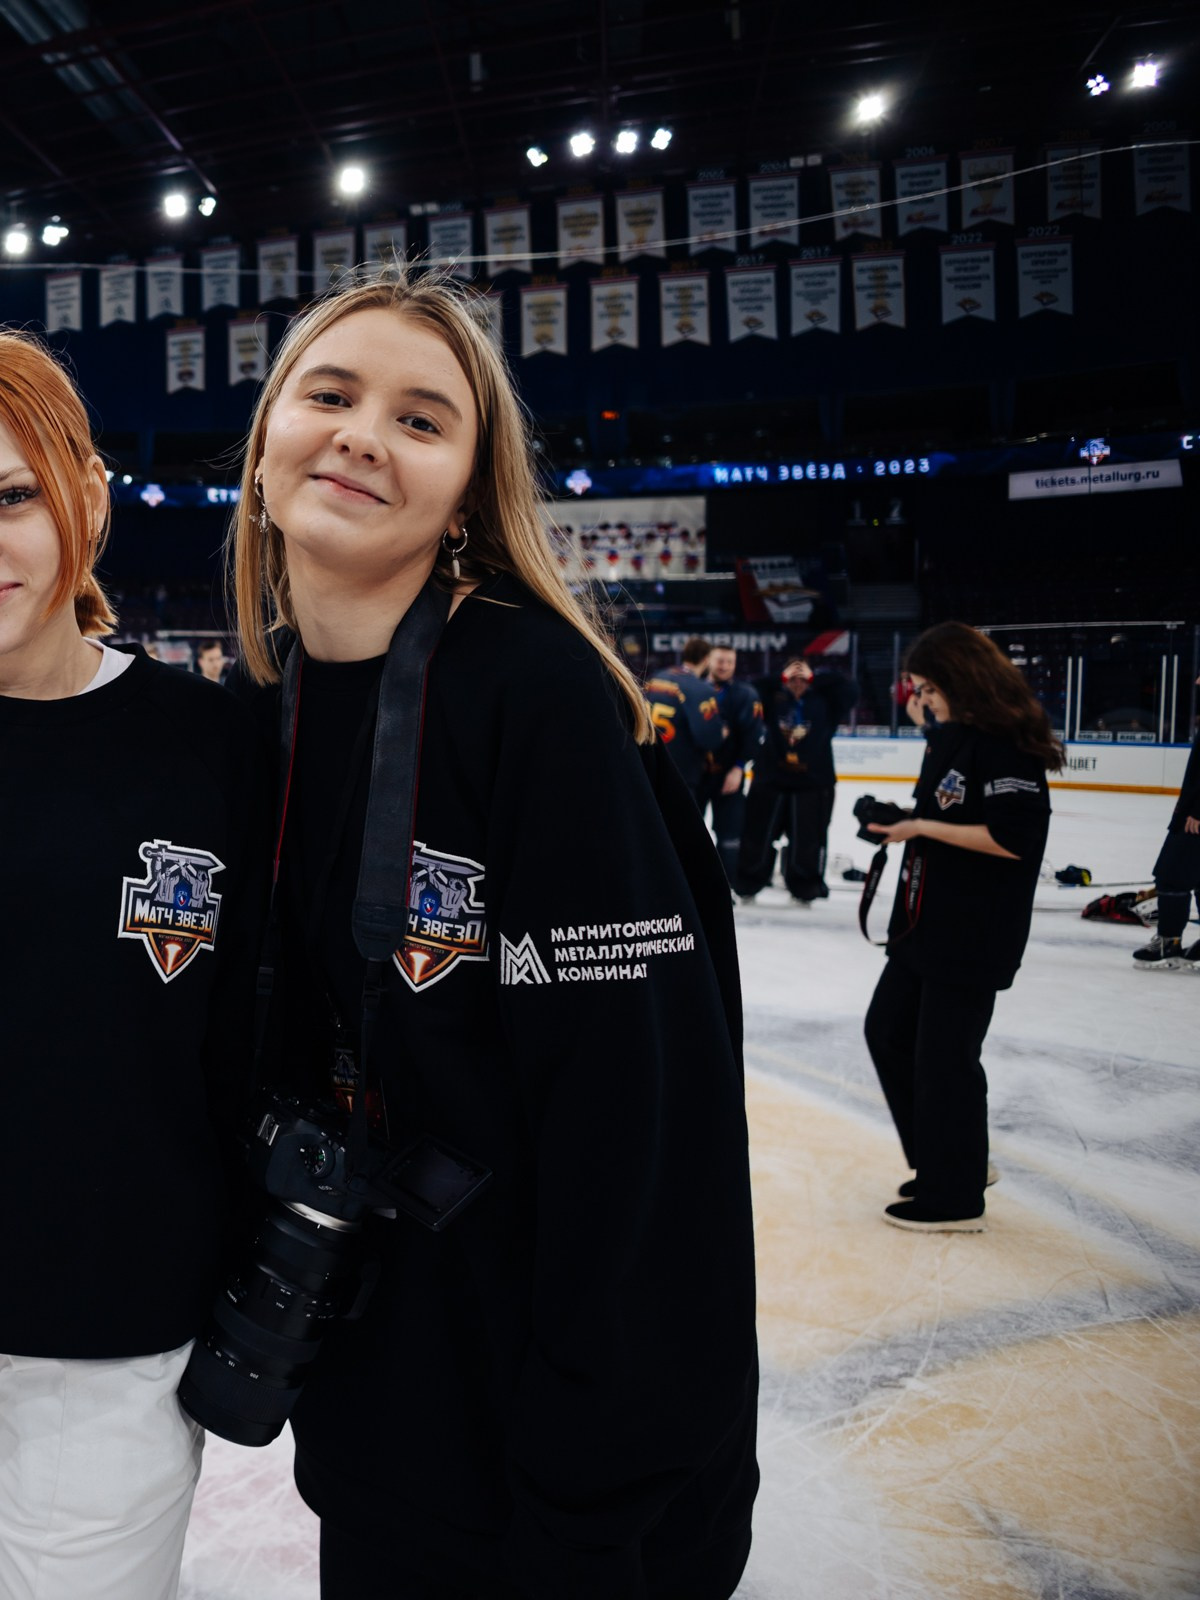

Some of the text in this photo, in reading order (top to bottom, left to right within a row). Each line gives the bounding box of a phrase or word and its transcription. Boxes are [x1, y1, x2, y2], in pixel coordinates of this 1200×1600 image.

[714, 465, 768, 484] МАТЧ
[874, 457, 930, 476] 2023
[1035, 469, 1160, 489] tickets.metallurg.ru
[551, 914, 682, 942] МАГНИТОГОРСКИЙ
[554, 933, 695, 962] МЕТАЛЛУРГИЧЕСКИЙ
[557, 963, 647, 982] КОМБИНАТ
